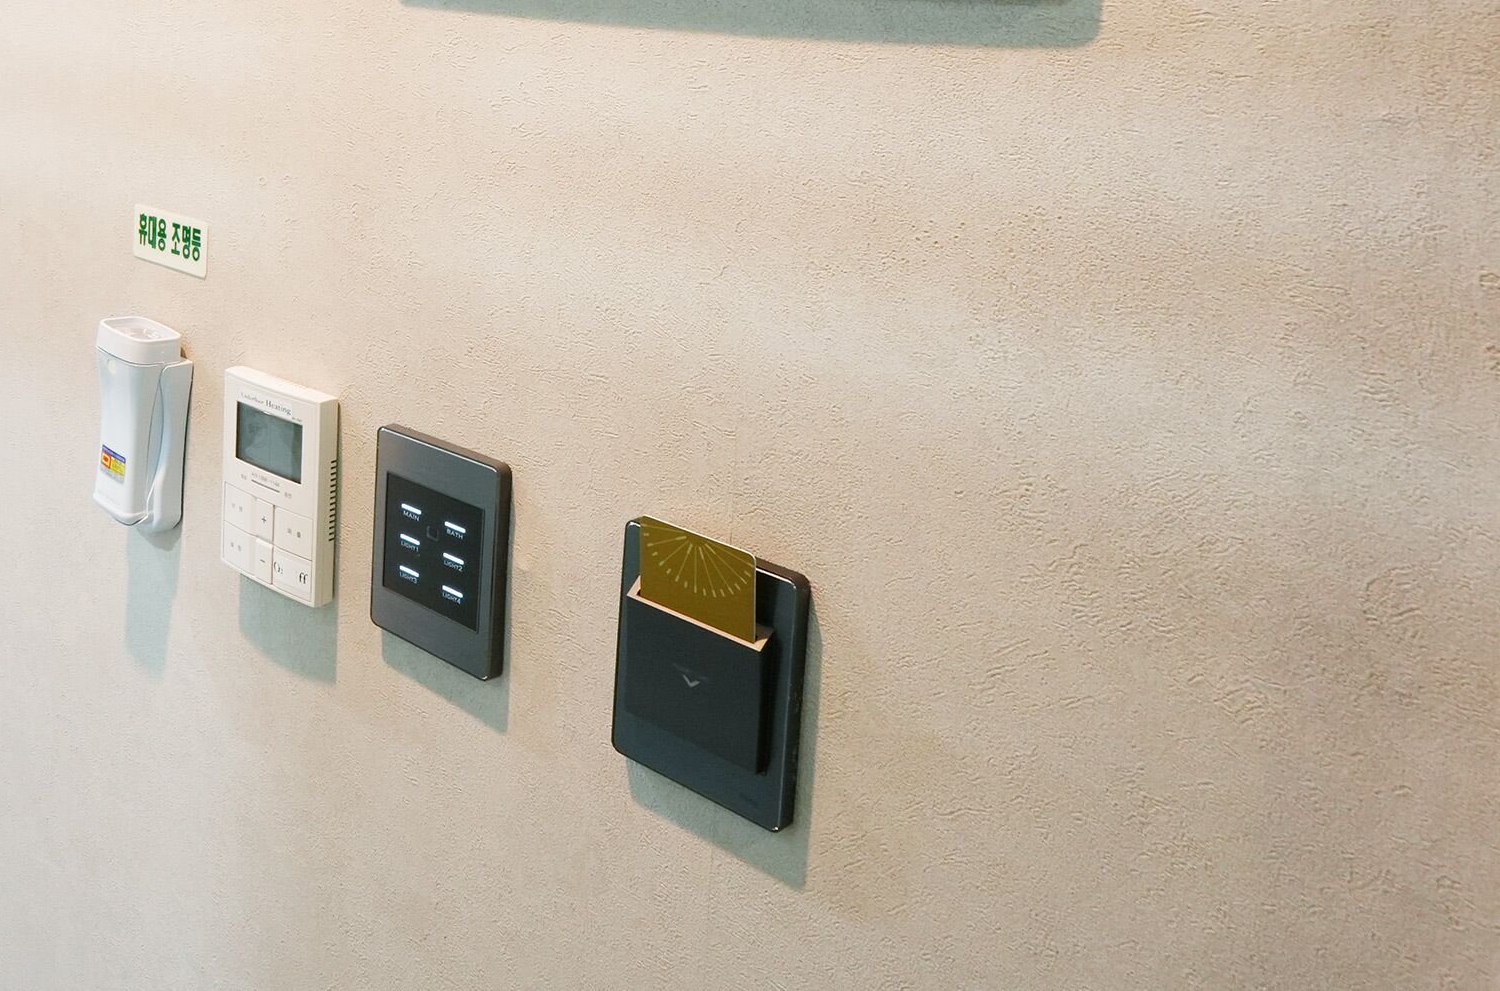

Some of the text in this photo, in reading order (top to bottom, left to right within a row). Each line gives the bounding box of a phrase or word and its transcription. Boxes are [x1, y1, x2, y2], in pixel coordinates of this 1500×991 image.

[138, 213, 202, 262] 휴대용 조명등
[265, 399, 292, 416] Heating
[403, 510, 420, 522] MAIN
[446, 528, 464, 540] BATH
[444, 560, 463, 572] LIGHT2
